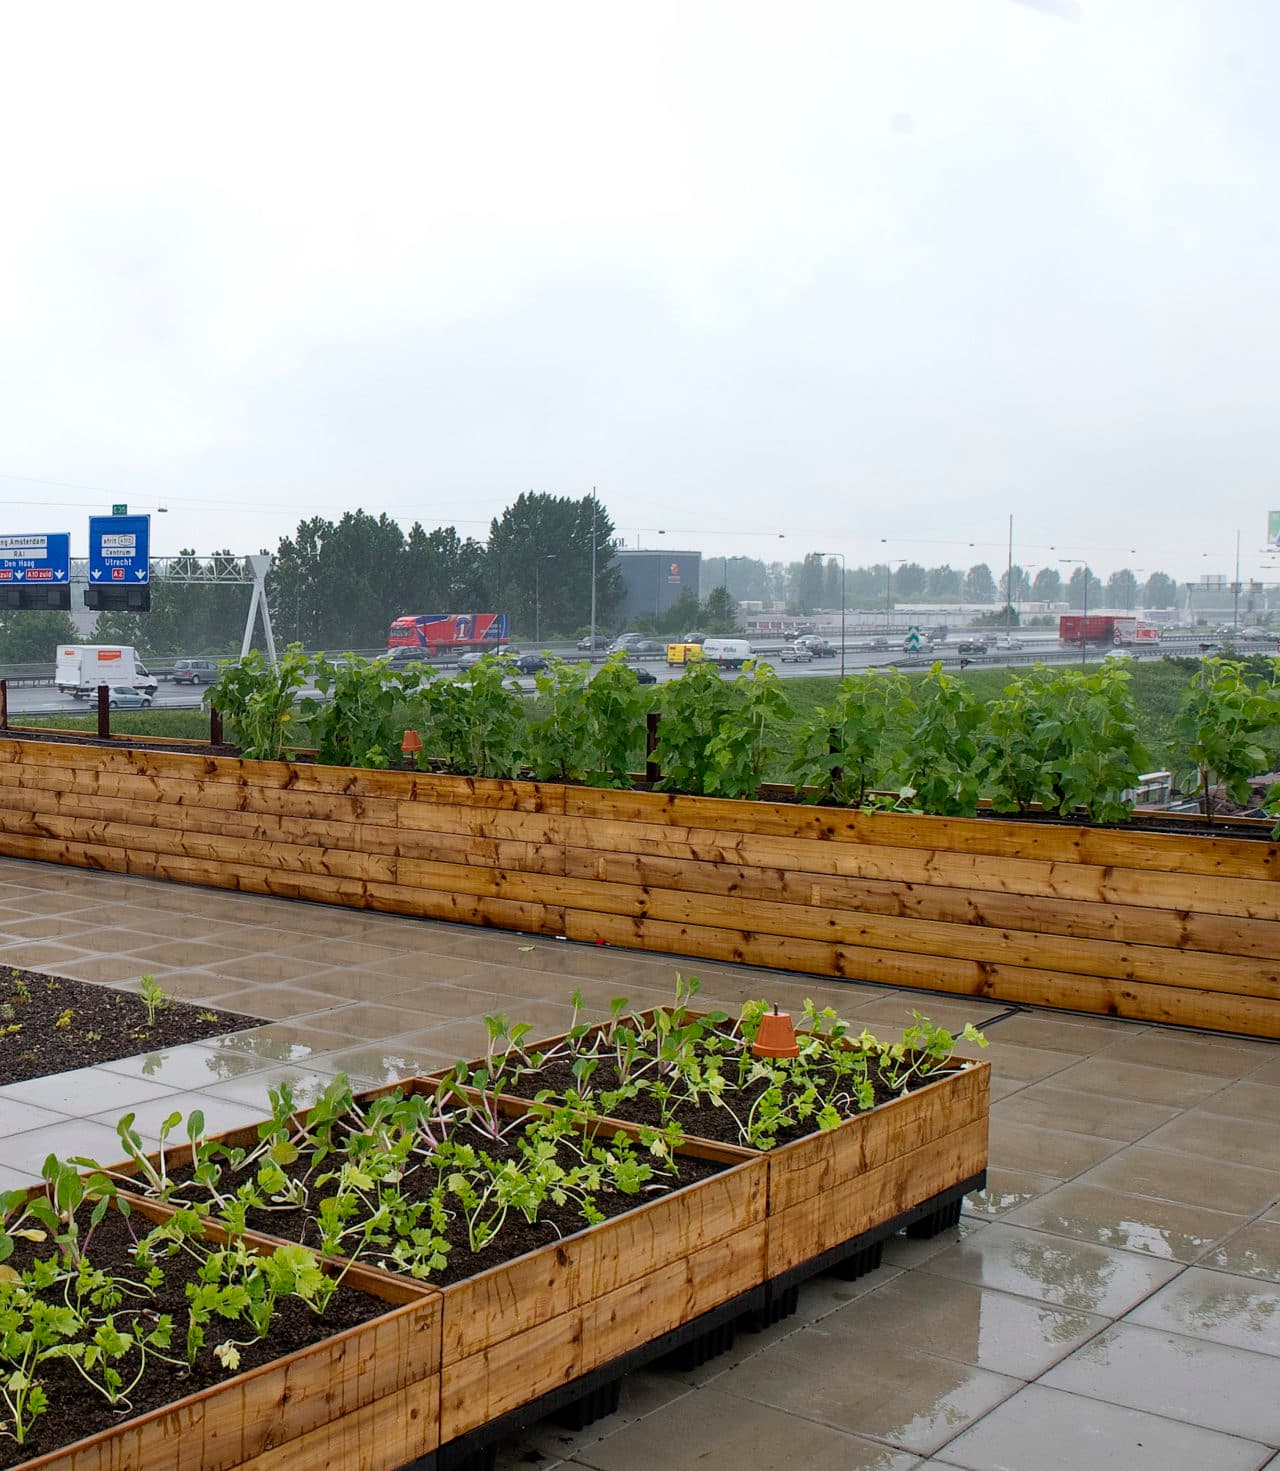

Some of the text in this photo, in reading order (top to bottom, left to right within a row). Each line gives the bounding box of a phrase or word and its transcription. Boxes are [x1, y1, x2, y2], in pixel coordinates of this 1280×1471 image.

[10, 537, 46, 545] Amsterdam
[18, 560, 35, 568] Haag
[104, 558, 132, 566] Utrecht
[39, 570, 52, 578] zuid
